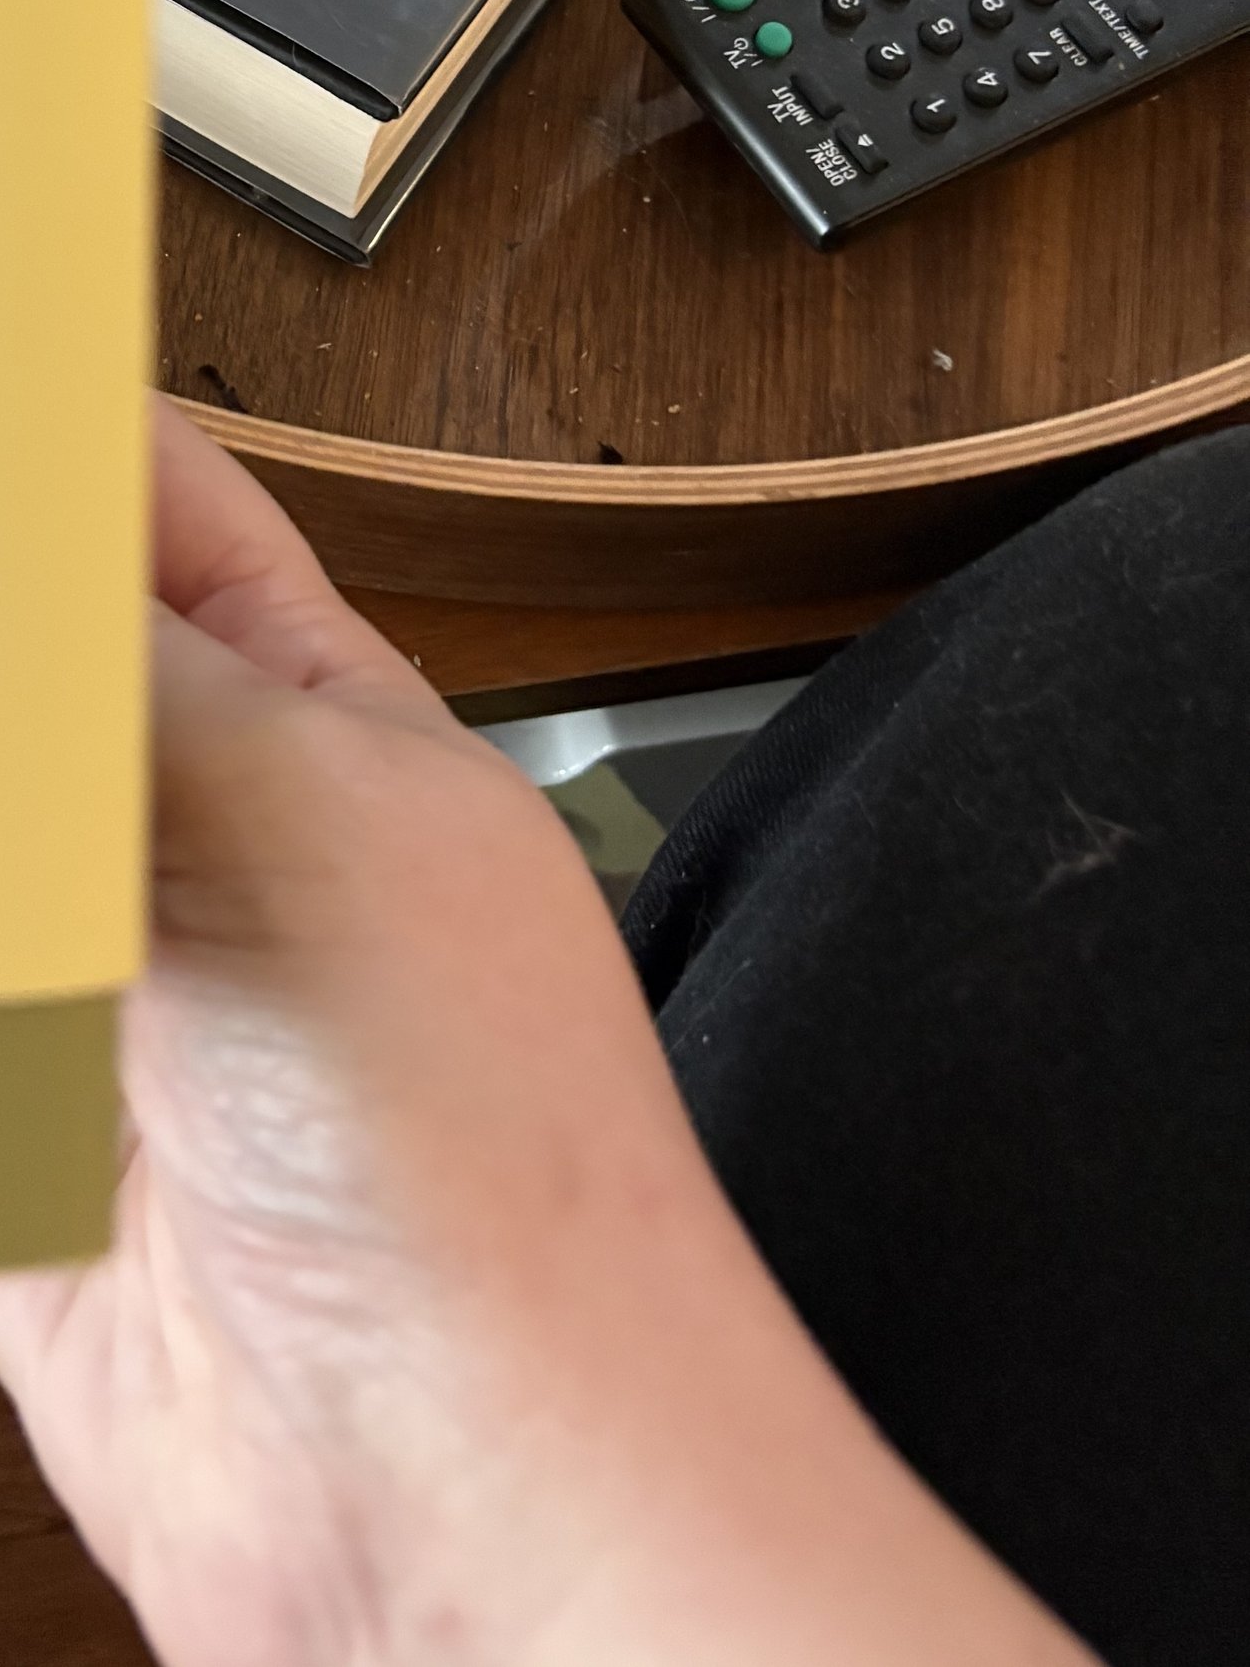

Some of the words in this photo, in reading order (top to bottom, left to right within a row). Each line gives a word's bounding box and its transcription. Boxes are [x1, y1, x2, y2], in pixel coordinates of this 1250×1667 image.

[931, 18, 955, 35] 5
[880, 42, 906, 61] 2
[1049, 26, 1089, 67] CLEAR
[723, 49, 747, 69] TV
[1027, 50, 1051, 65] 7
[976, 70, 999, 87] 4
[767, 102, 791, 124] TV
[771, 86, 814, 127] INPUT
[926, 98, 946, 113] 1
[805, 147, 846, 187] OPEN/
[817, 138, 858, 181] CLOSE
